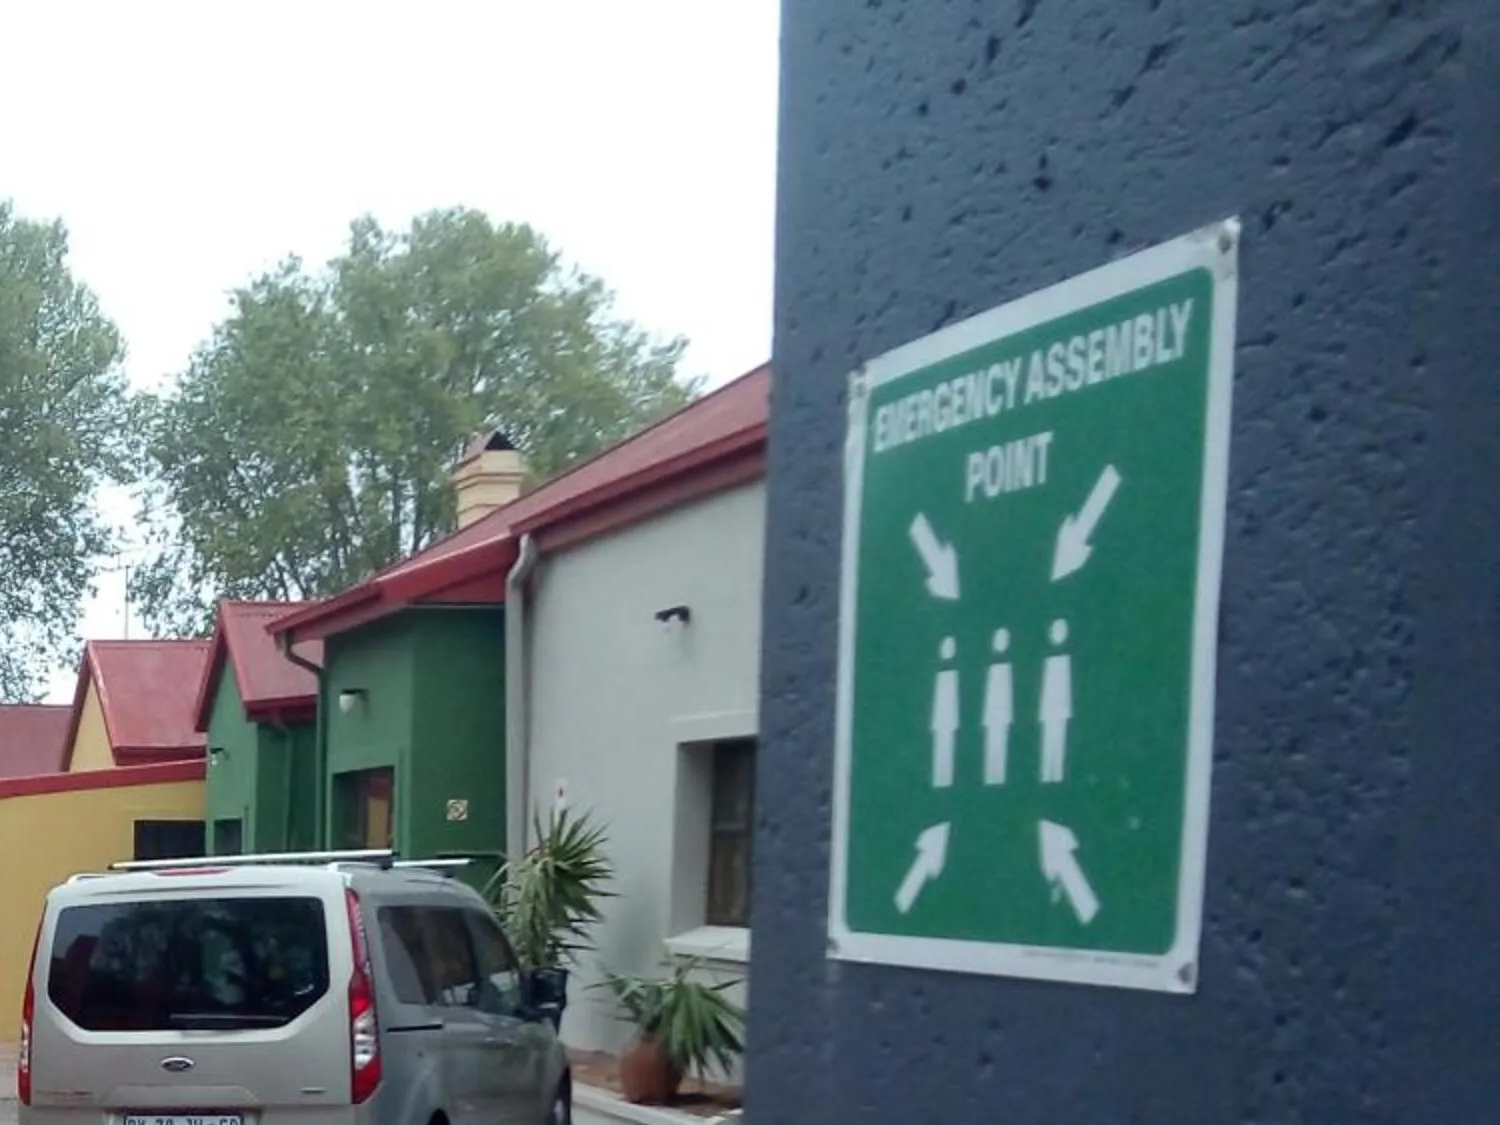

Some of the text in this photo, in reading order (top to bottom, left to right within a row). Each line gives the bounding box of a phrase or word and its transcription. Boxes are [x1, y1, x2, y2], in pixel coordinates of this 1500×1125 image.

[873, 298, 1195, 453] EMERGENCY ASSEMBLY
[965, 431, 1053, 503] POINT
